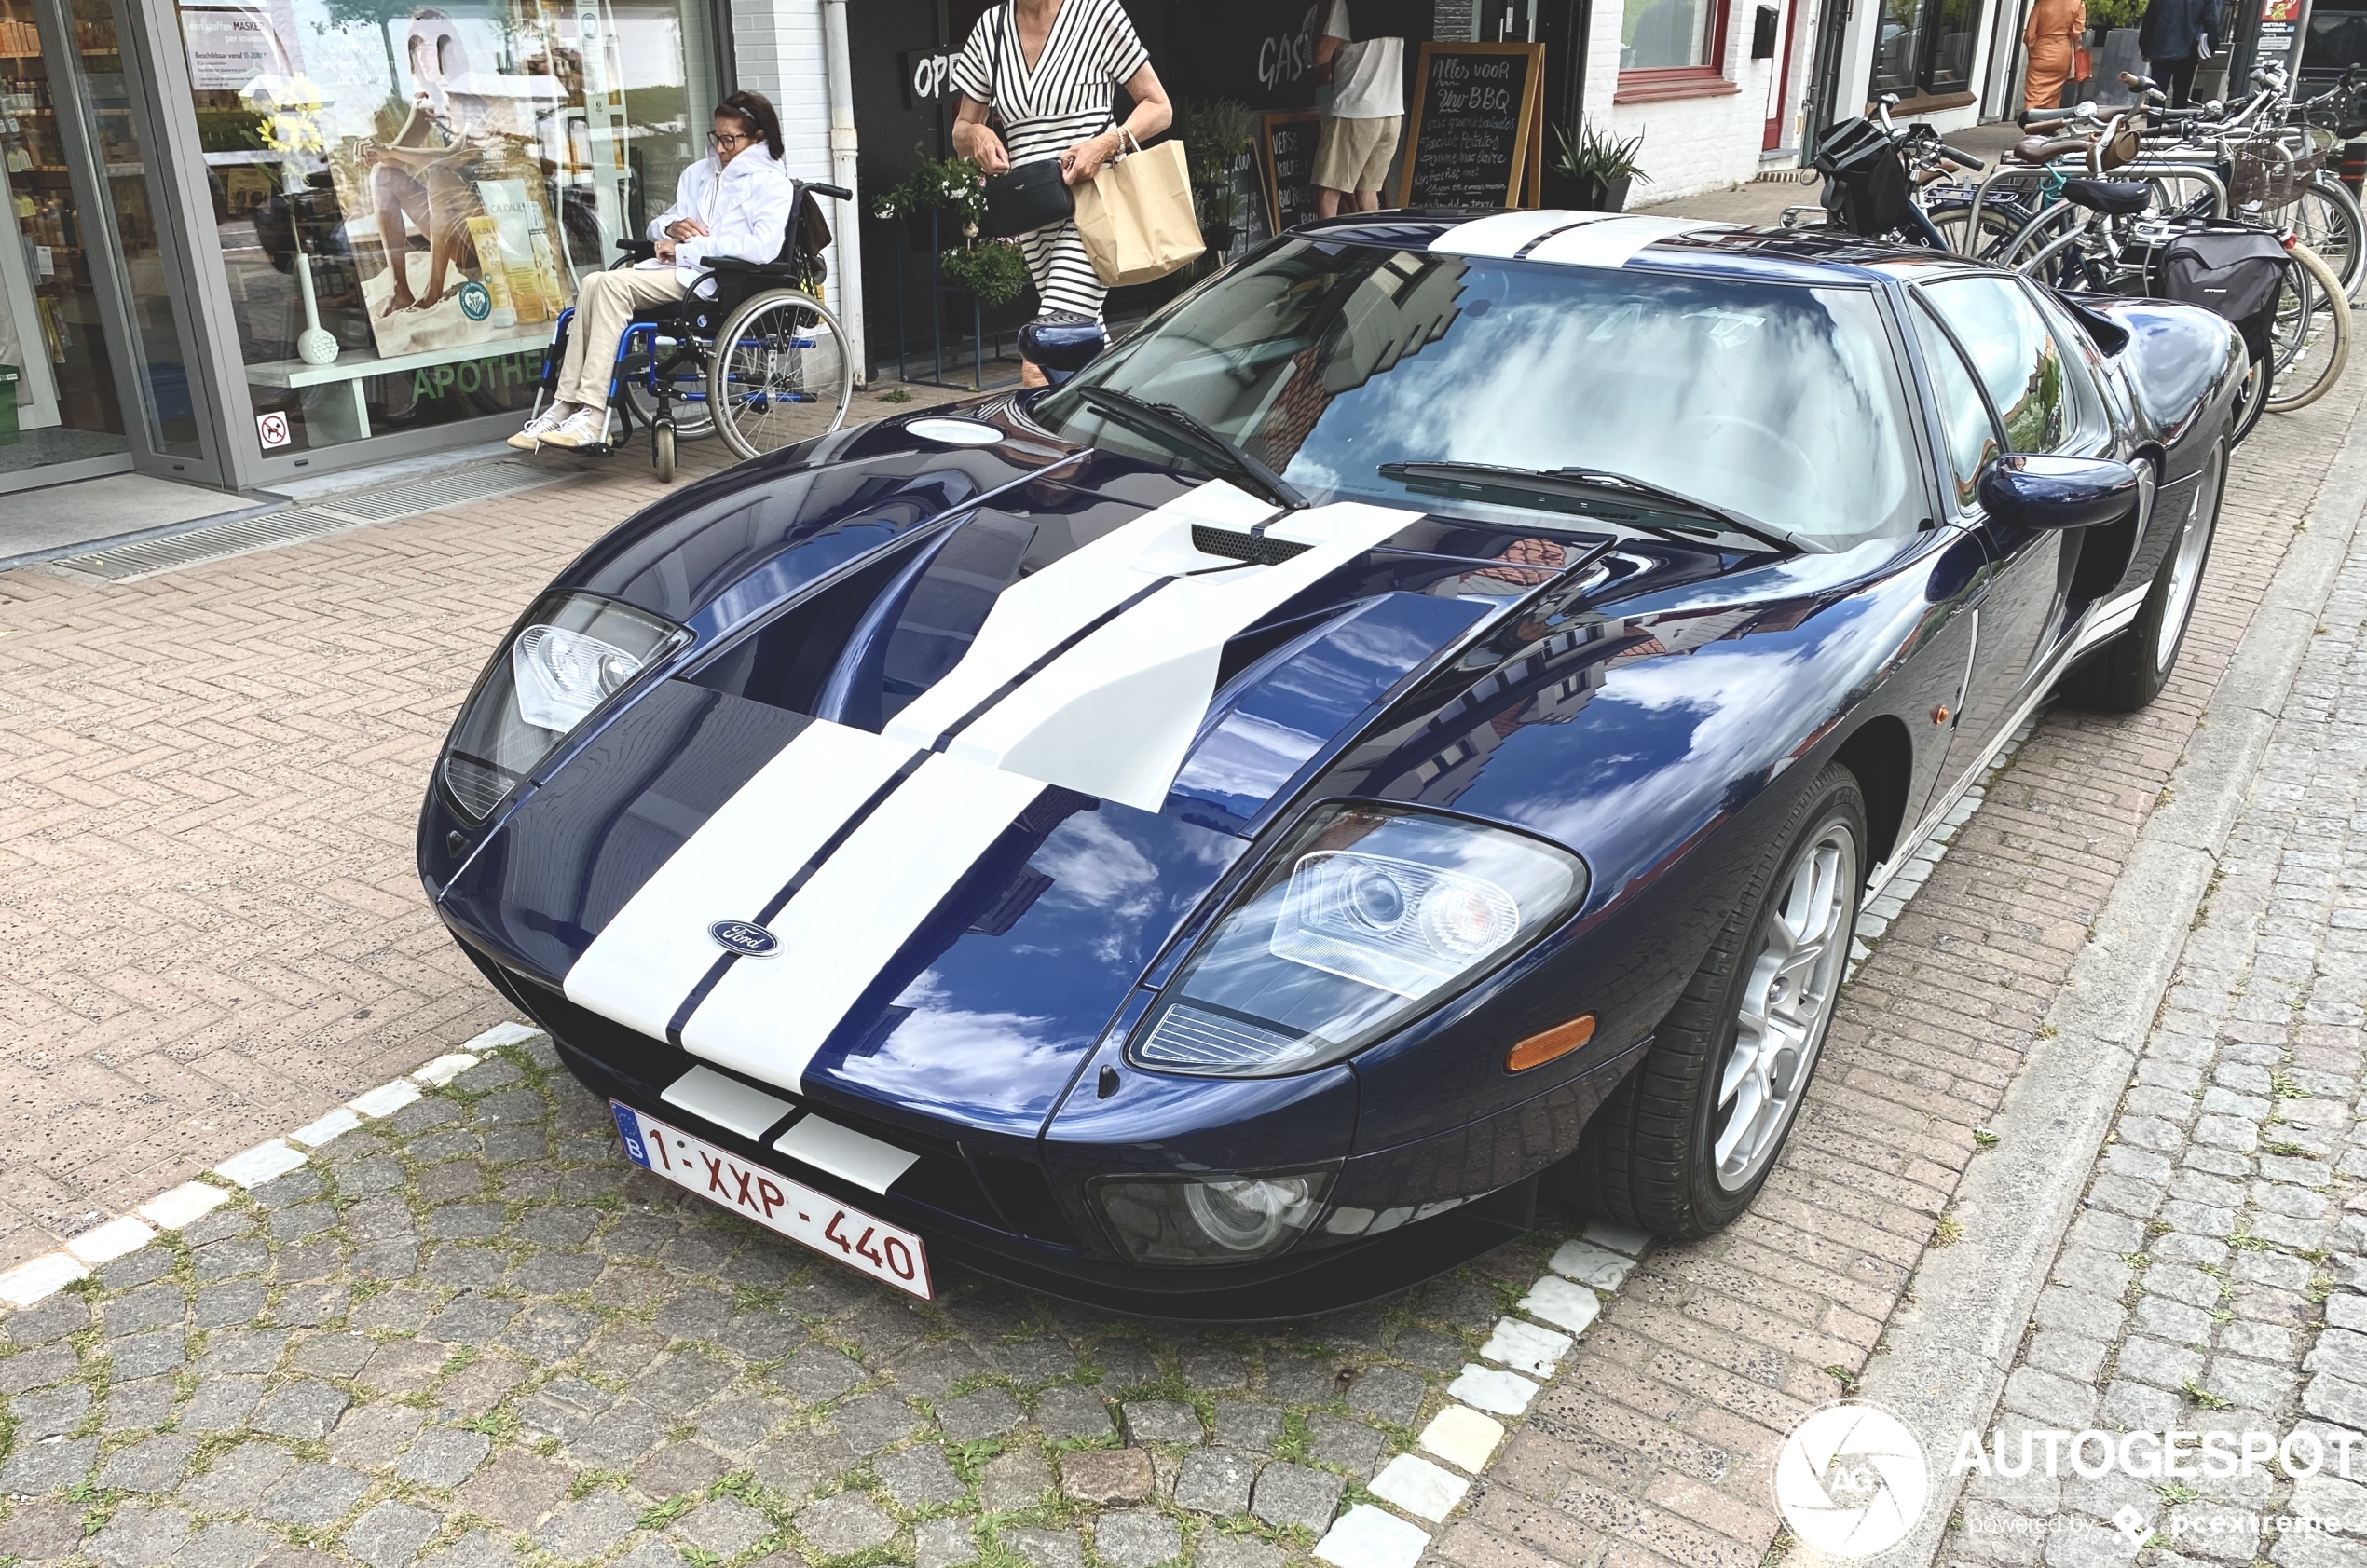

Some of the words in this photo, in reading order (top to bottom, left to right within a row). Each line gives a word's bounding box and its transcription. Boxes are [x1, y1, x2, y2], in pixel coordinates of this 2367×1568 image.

[1432, 58, 1470, 80] Alles
[722, 925, 766, 948] Ford
[625, 1137, 644, 1159] B
